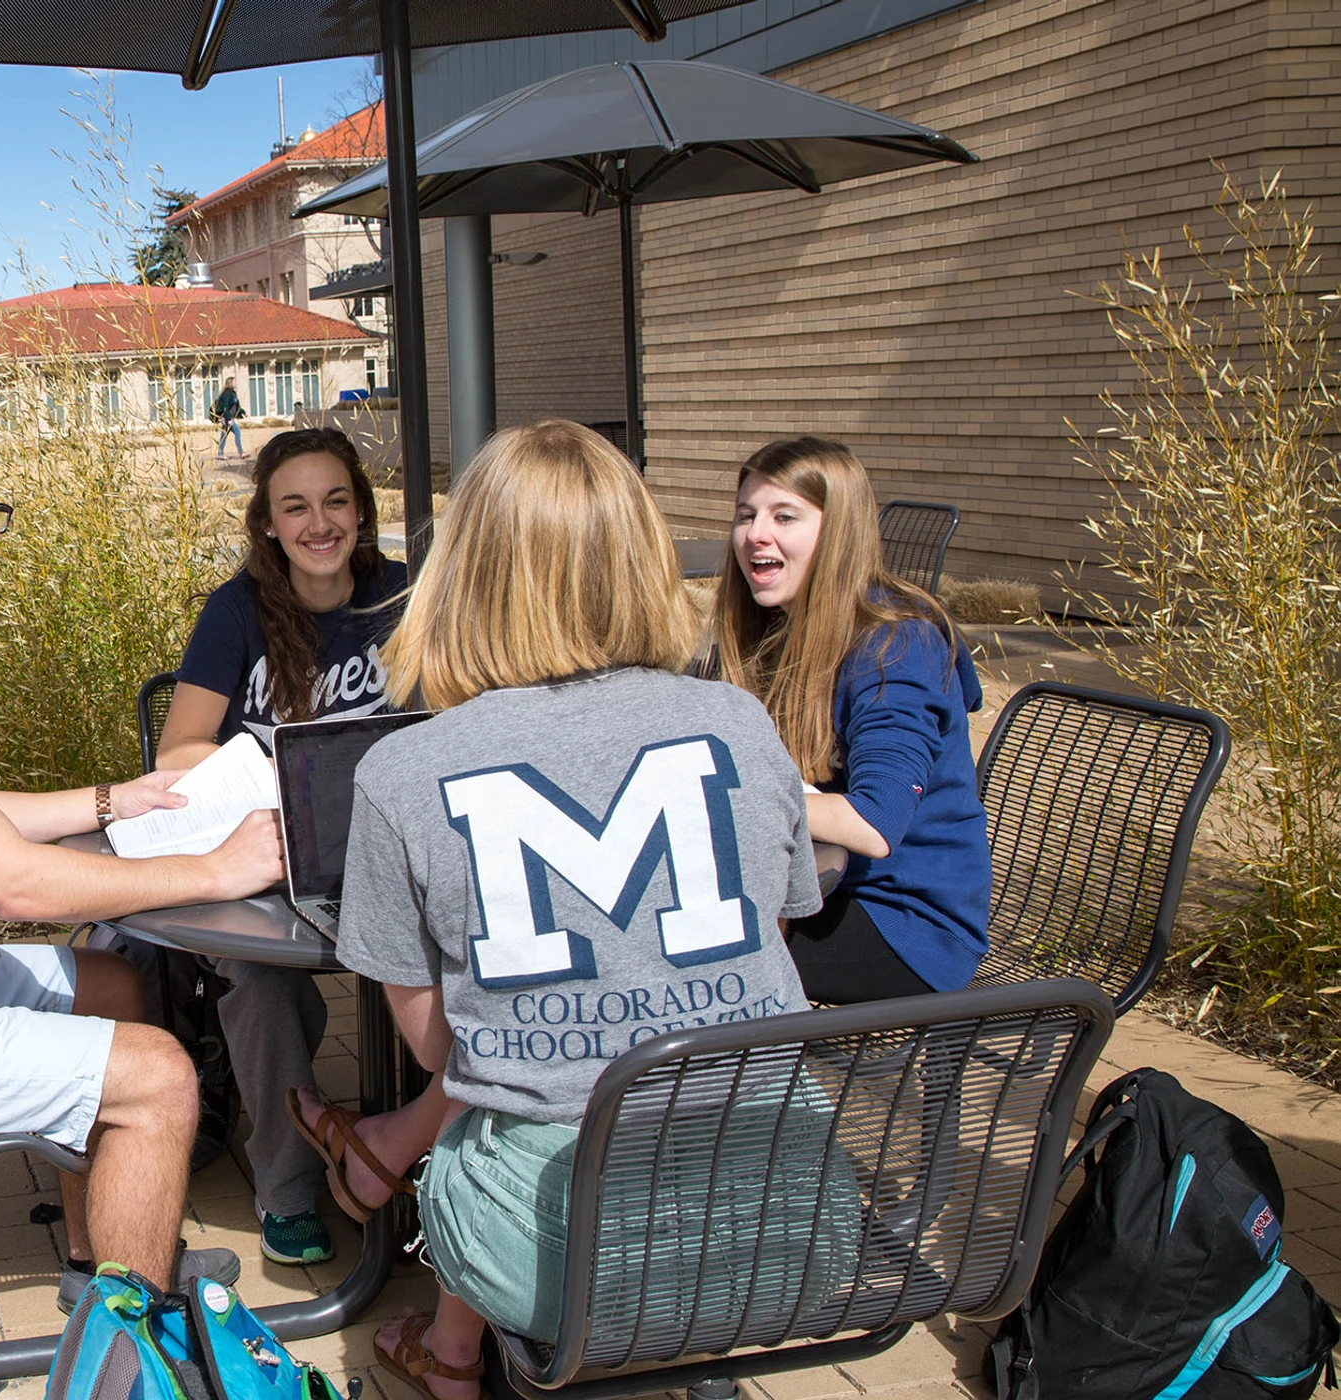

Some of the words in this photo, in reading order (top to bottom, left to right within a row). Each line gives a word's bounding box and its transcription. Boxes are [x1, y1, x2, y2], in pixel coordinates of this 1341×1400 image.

[244, 644, 389, 723] Mnes
[439, 733, 761, 989] M
[513, 972, 745, 1024] COLORADO
[453, 1025, 618, 1061] SCHOOL
